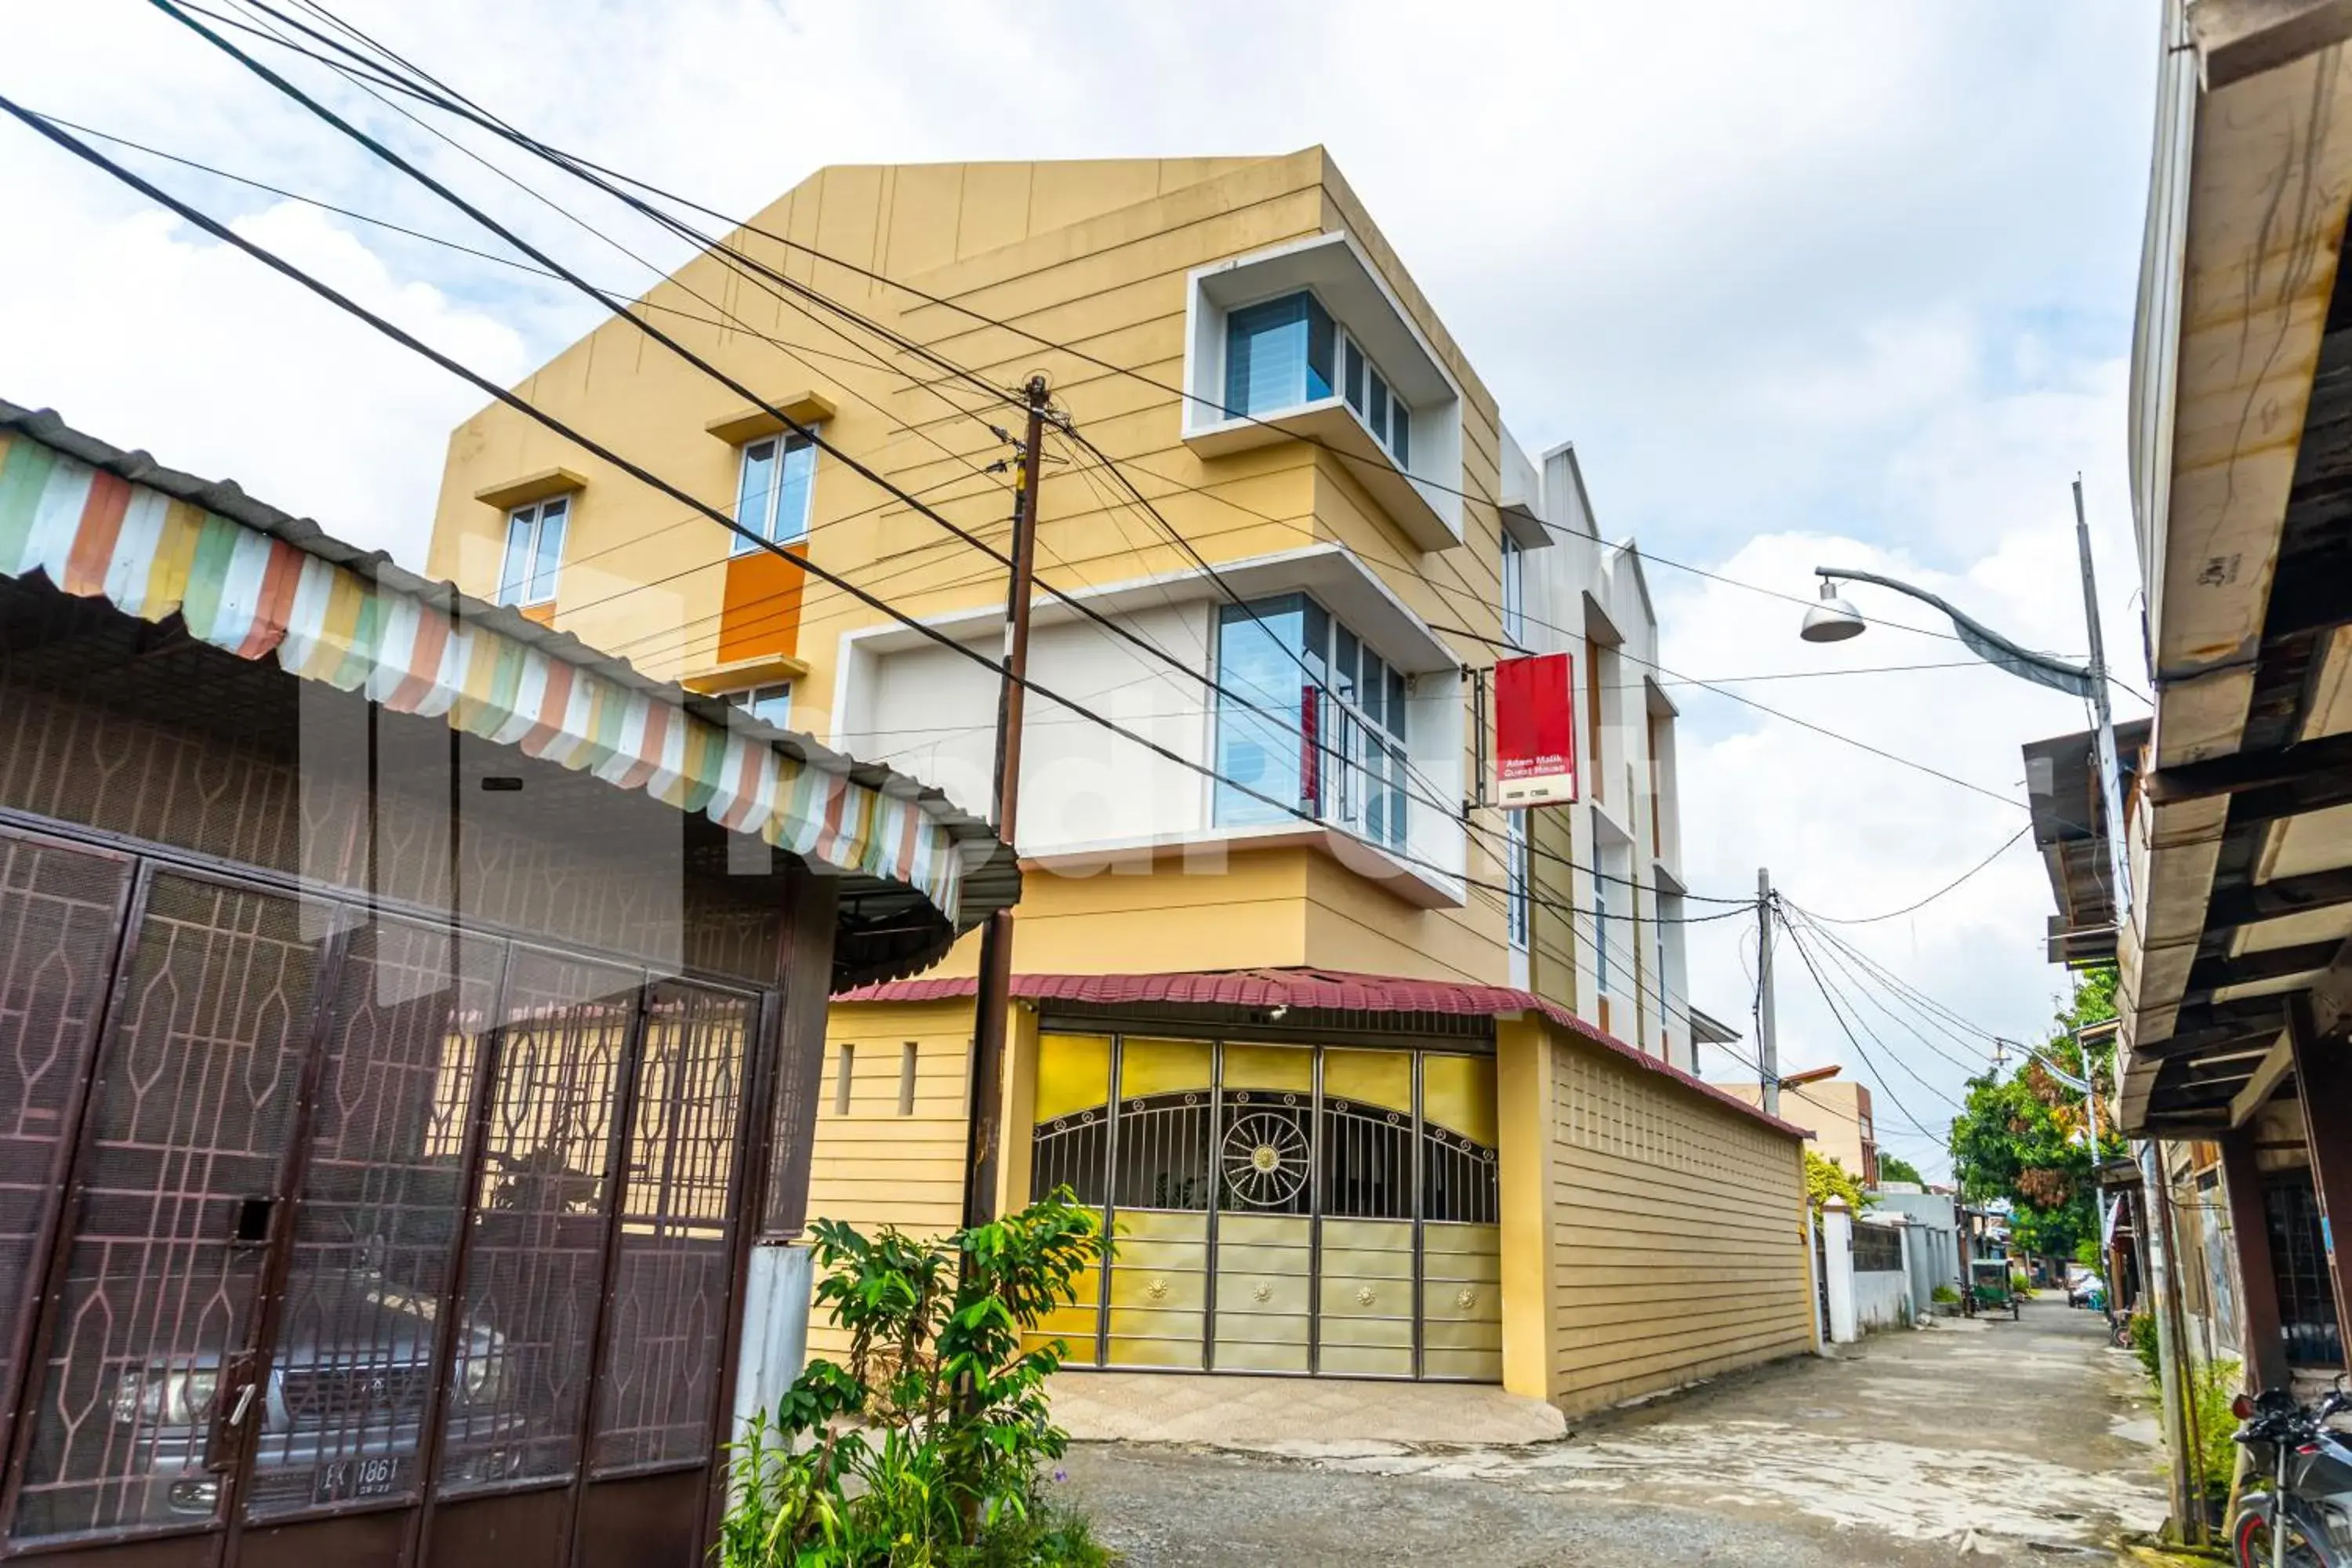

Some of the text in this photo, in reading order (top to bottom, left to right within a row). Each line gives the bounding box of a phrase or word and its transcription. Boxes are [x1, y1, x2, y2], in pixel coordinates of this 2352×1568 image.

[1506, 754, 1563, 768] Adam Malik
[1504, 764, 1566, 777] Guest House
[358, 1457, 398, 1483] 1861
